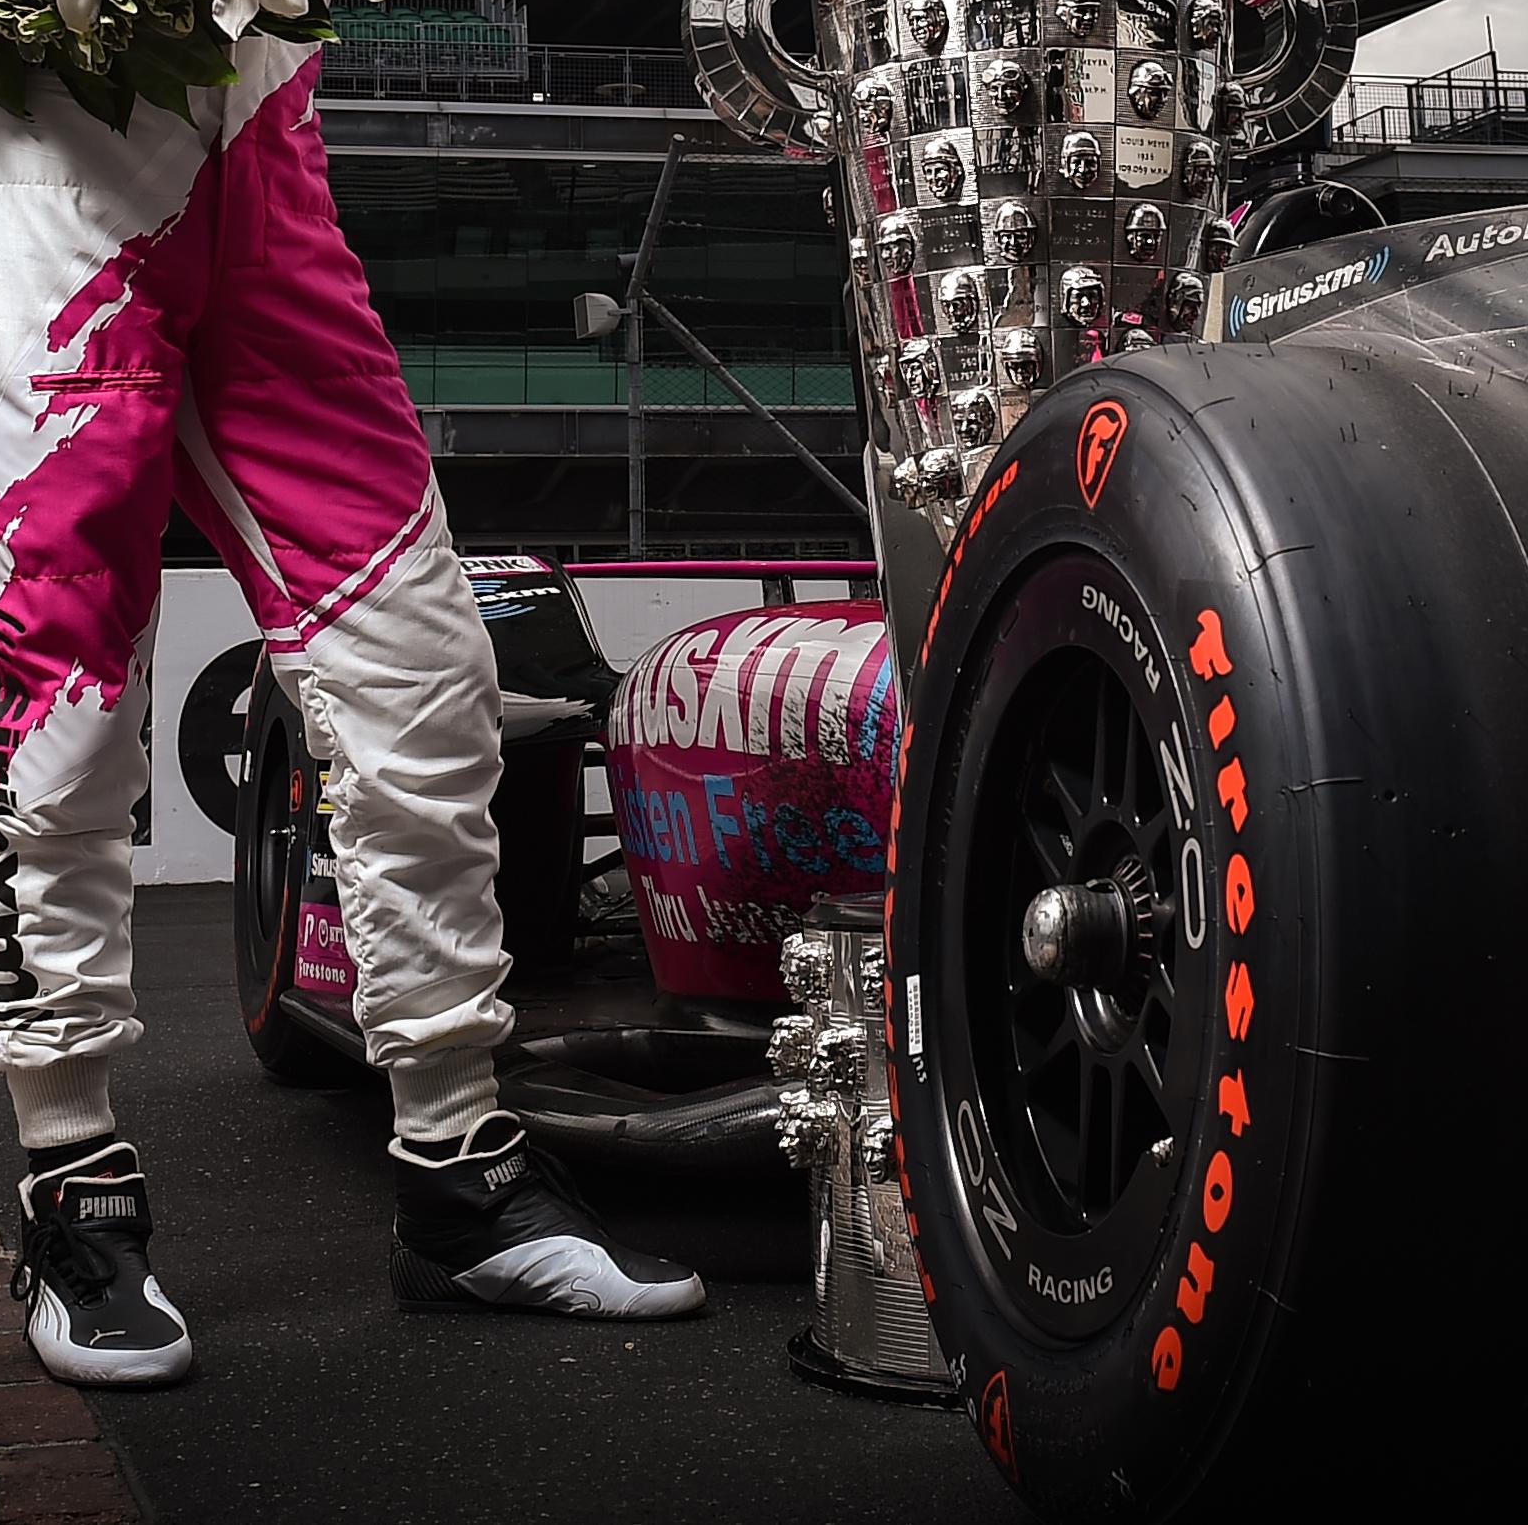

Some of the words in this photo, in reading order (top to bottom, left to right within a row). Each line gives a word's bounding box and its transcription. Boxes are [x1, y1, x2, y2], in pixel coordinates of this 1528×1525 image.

[1082, 585, 1161, 694] RACING
[702, 775, 885, 873] Free
[641, 875, 698, 942] Thru
[298, 956, 346, 985] Firestone
[79, 1194, 137, 1220] PUMA
[1027, 1263, 1114, 1304] RACING
